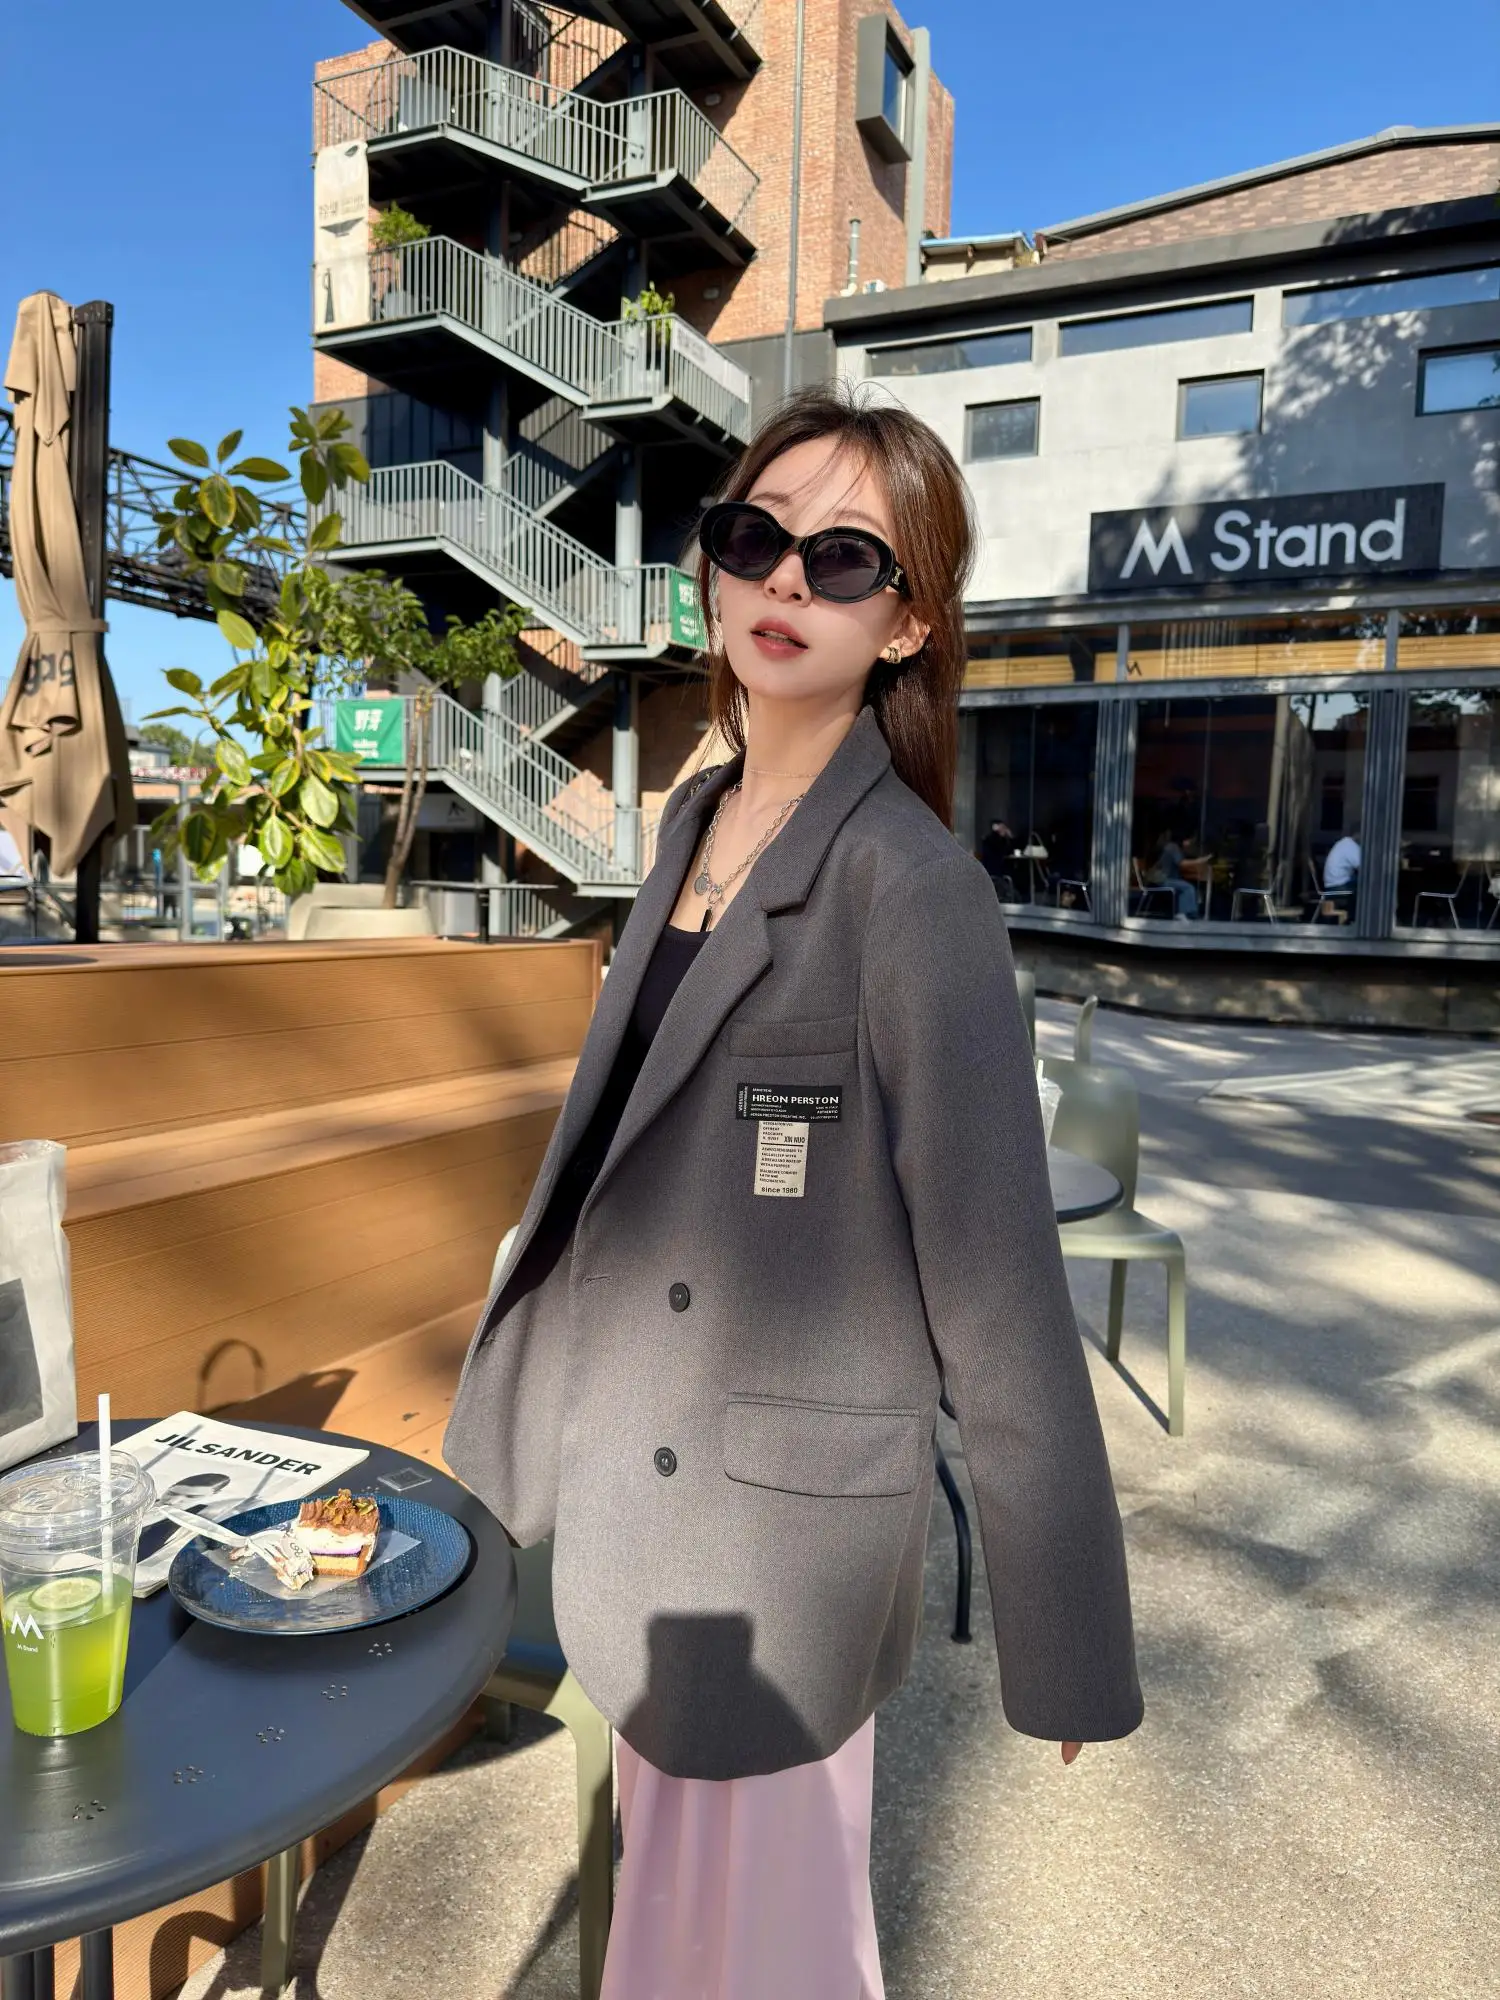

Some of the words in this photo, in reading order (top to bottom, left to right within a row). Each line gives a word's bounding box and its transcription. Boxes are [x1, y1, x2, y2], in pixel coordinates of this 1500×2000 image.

[1119, 516, 1193, 579] M
[1210, 497, 1406, 573] Stand
[752, 1094, 788, 1104] HREON
[791, 1096, 839, 1105] PERSTON
[10, 1610, 45, 1640] M
